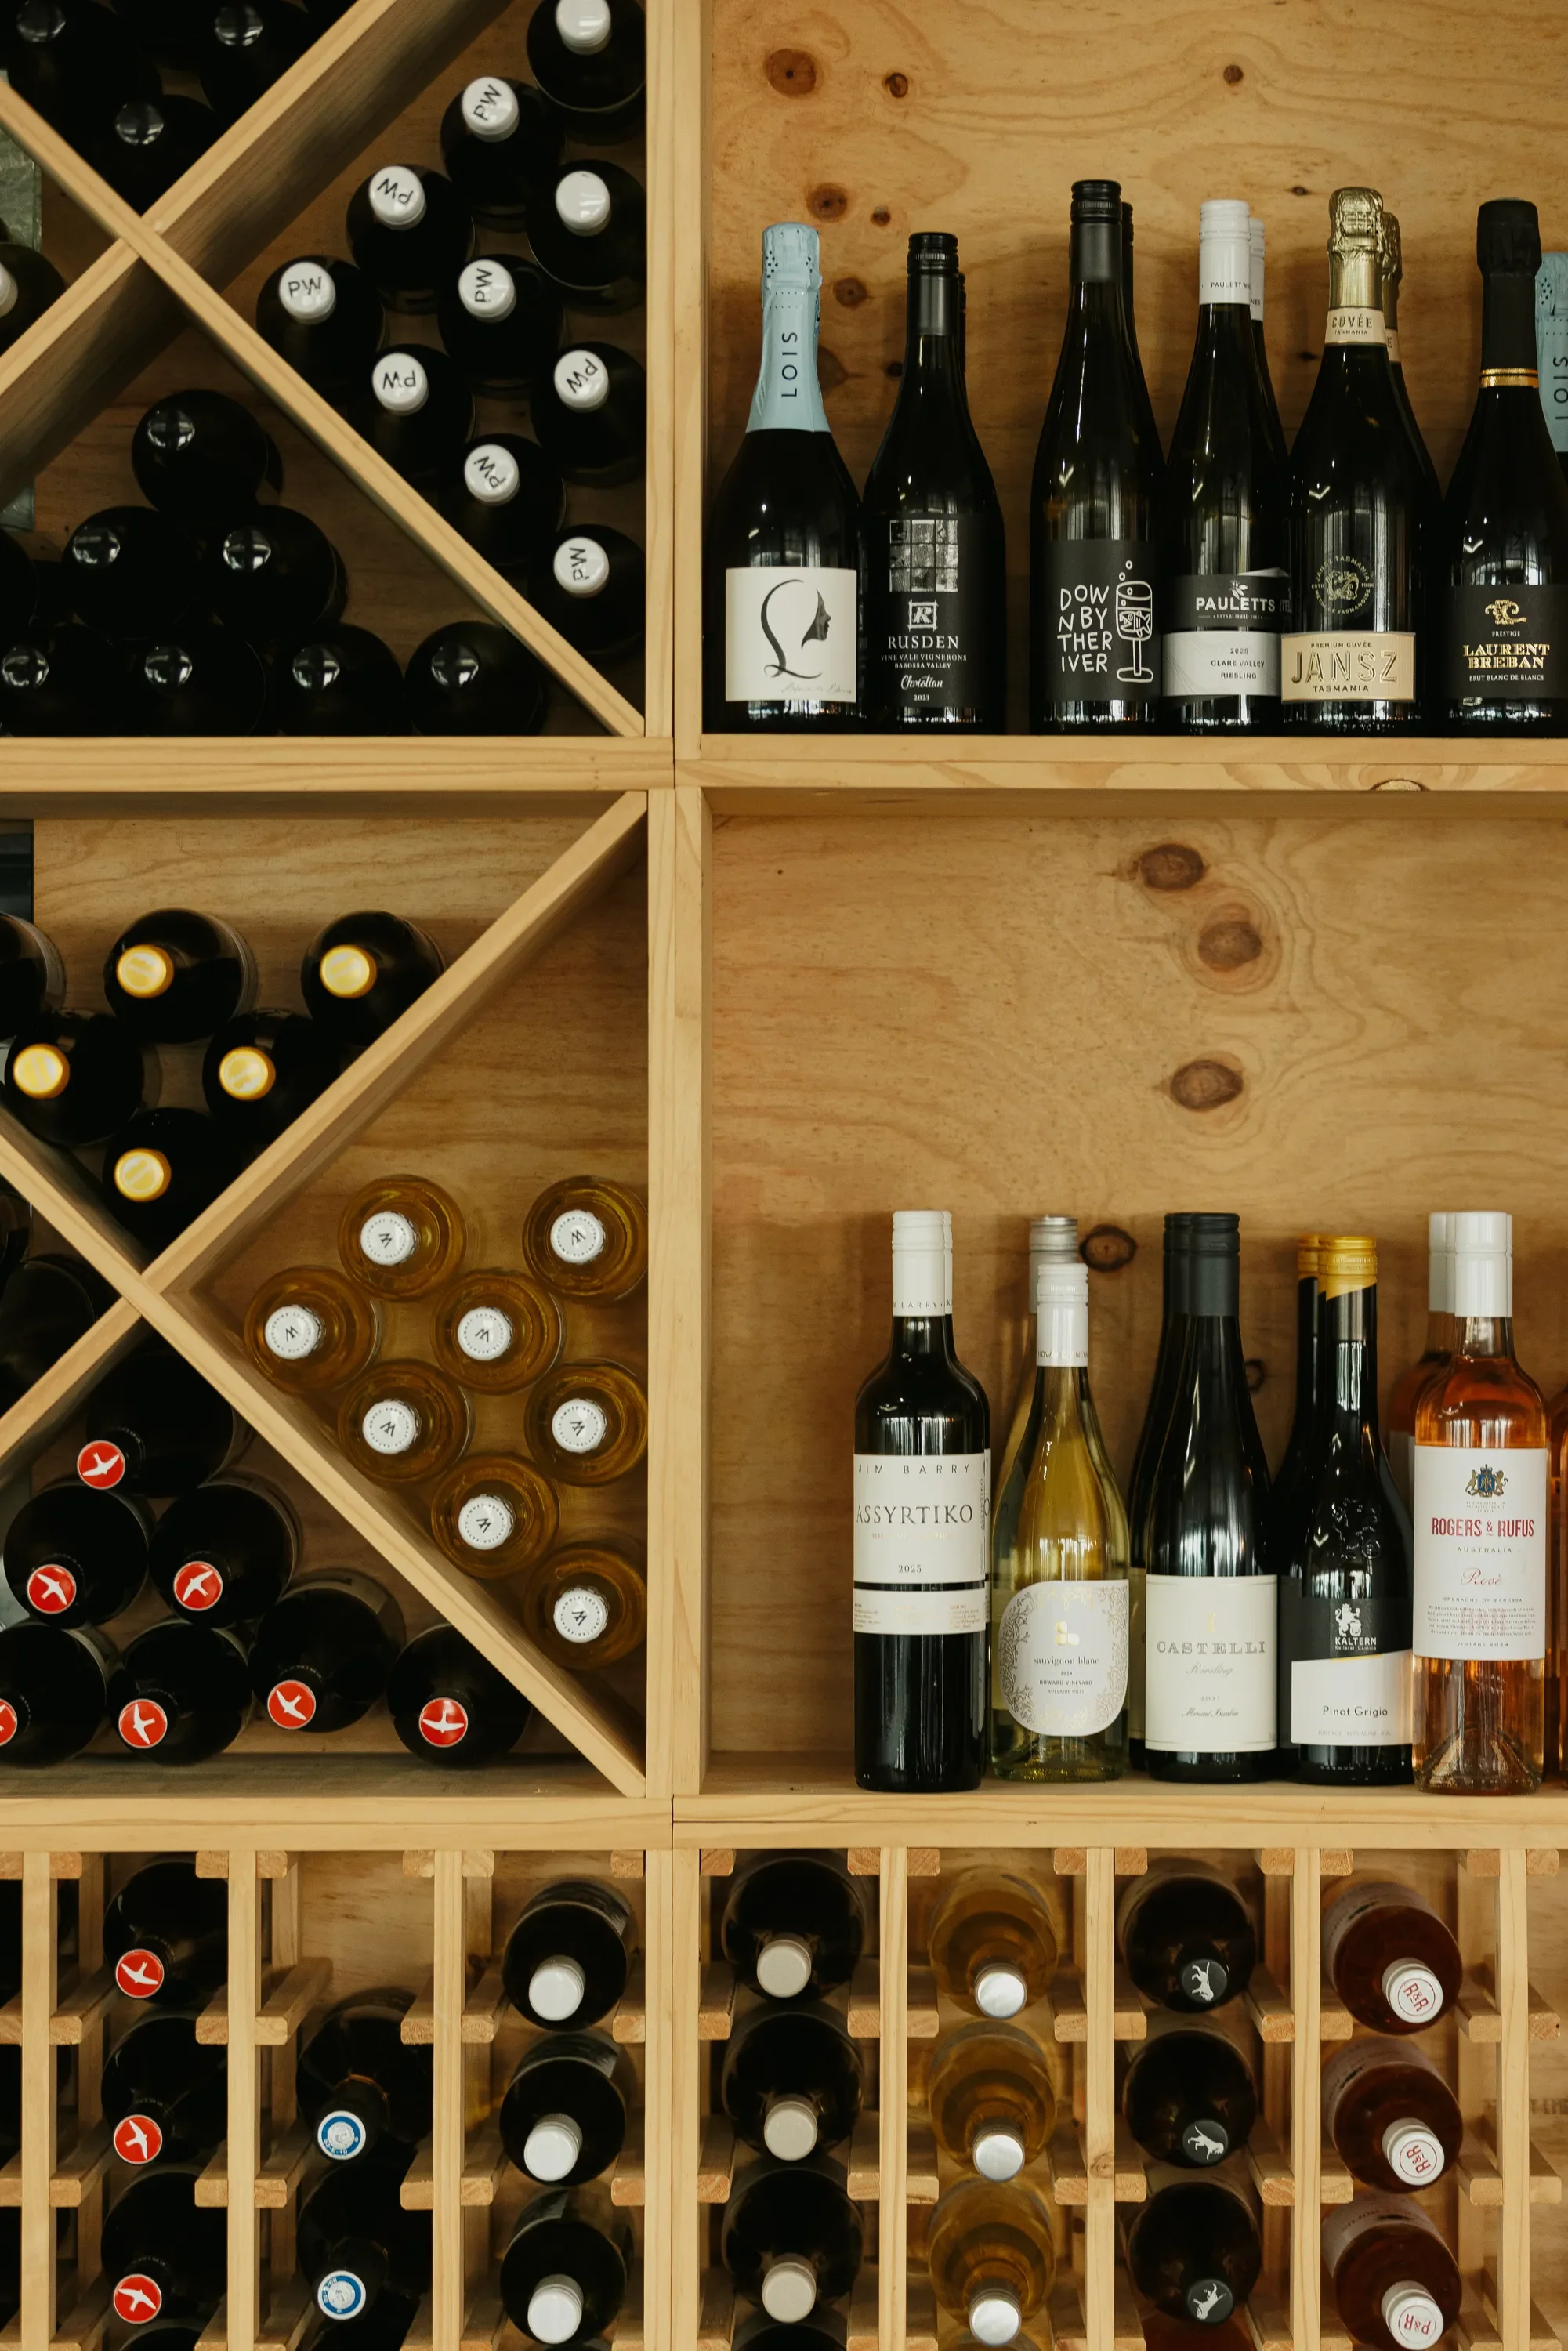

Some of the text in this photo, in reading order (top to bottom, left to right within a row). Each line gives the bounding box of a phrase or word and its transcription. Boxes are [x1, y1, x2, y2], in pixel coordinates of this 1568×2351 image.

[473, 85, 502, 121] PW
[376, 177, 414, 206] PW
[288, 276, 322, 299] PW
[474, 268, 493, 303] PW
[1332, 313, 1373, 329] CUVÉE
[781, 332, 798, 397] LOIS
[382, 370, 416, 390] PW
[566, 358, 599, 394] PW
[473, 455, 507, 490] PW
[569, 547, 591, 581] PW
[1060, 584, 1110, 612] DOW
[1196, 596, 1276, 613] PAULETTS
[888, 635, 959, 650] RUSDEN
[1057, 630, 1113, 653] THER
[1462, 643, 1551, 657] LAURENT
[920, 654, 967, 662] VIGNERONS
[1061, 653, 1108, 673] IVER
[1239, 659, 1266, 668] VALLEY
[1291, 650, 1398, 684] JANSZ
[1468, 656, 1545, 669] BREBAN
[900, 674, 944, 690] Christian
[1220, 672, 1258, 680] RIESLING
[1313, 684, 1370, 693] TASMANIA
[901, 1301, 937, 1310] BARRY
[858, 1463, 969, 1474] JIM BARRY
[856, 1504, 973, 1524] ASSYRTIKO
[1432, 1516, 1534, 1538] ROGERS & RUFUS
[898, 1564, 922, 1574] 2025
[1157, 1640, 1266, 1655] CASTELLI
[1334, 1636, 1378, 1646] KALTERN
[1033, 1655, 1099, 1667] sauvignon blanc
[1323, 1705, 1389, 1719] Pinot Grigio
[1403, 1982, 1429, 2012] R&R
[1406, 2144, 1432, 2174] R&R
